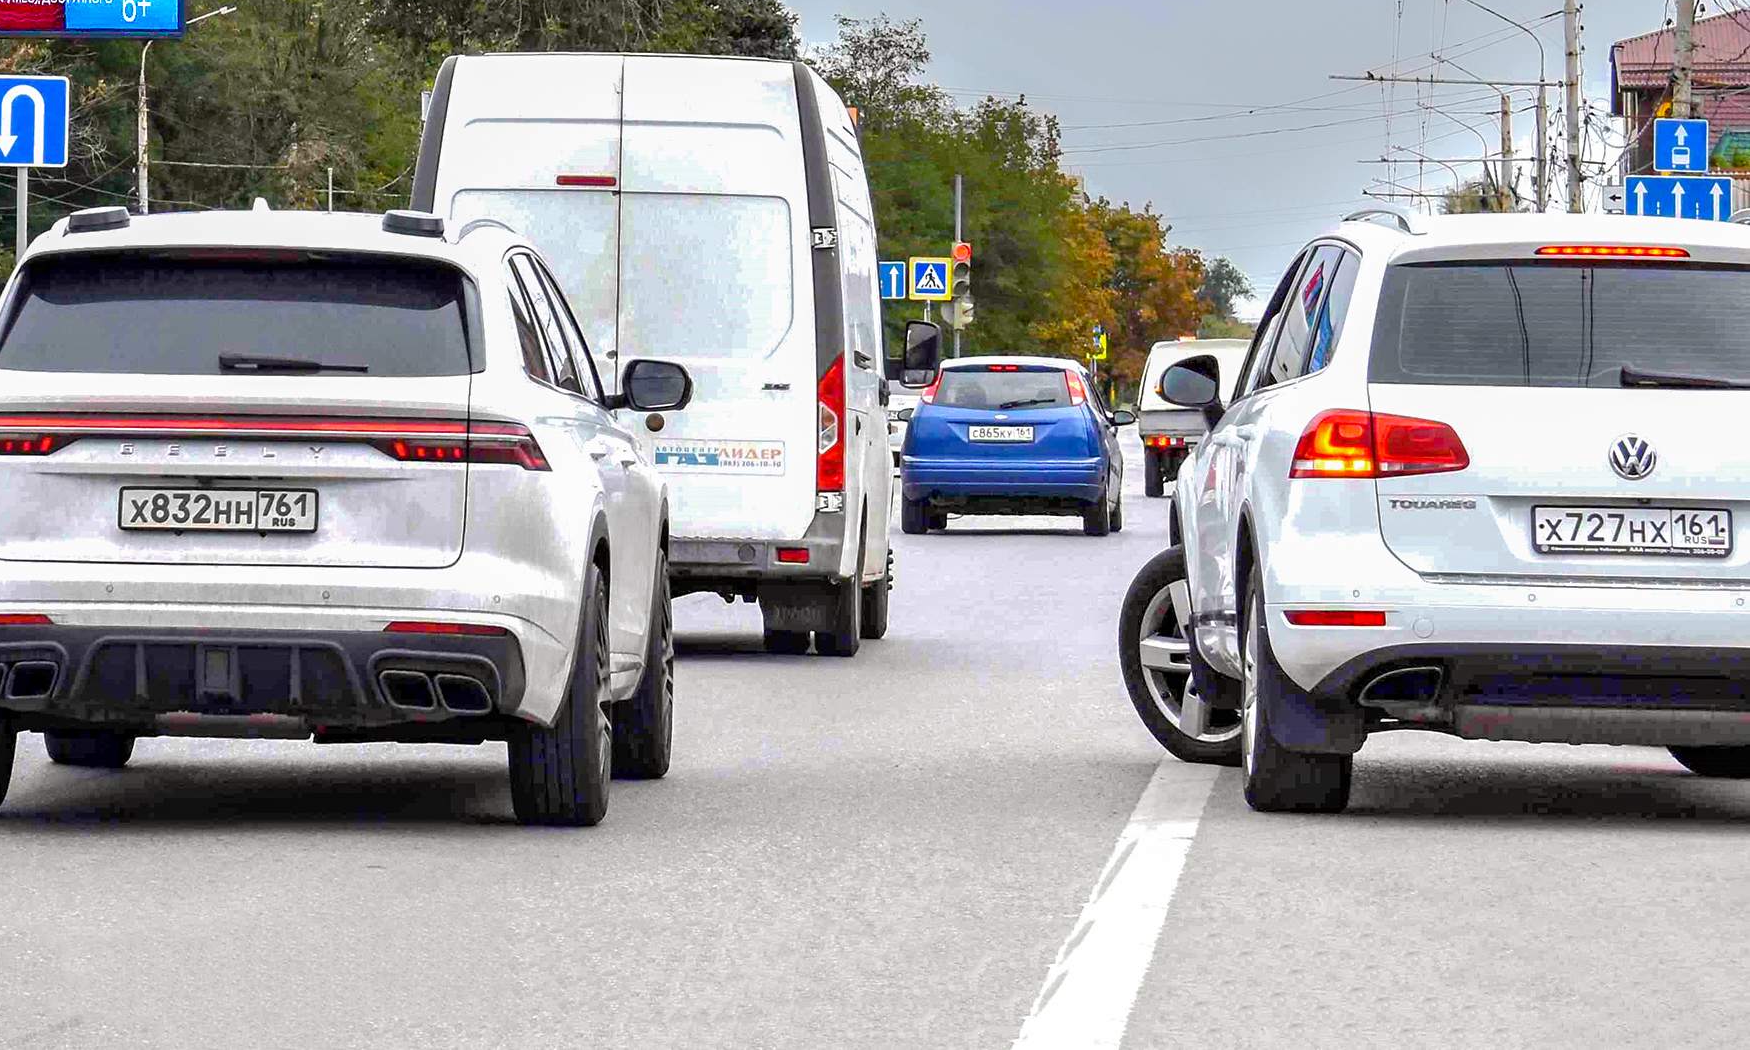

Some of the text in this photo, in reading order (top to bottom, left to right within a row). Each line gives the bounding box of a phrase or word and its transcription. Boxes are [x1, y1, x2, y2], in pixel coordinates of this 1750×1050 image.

[119, 443, 325, 460] GEELY
[719, 447, 782, 460] ЛИДЕР
[130, 493, 308, 525] Х832НН 761
[1389, 500, 1477, 510] TOUAREG
[272, 517, 296, 528] RUS
[1545, 512, 1720, 543] Х727НХ 161
[1684, 536, 1707, 545] RUS
